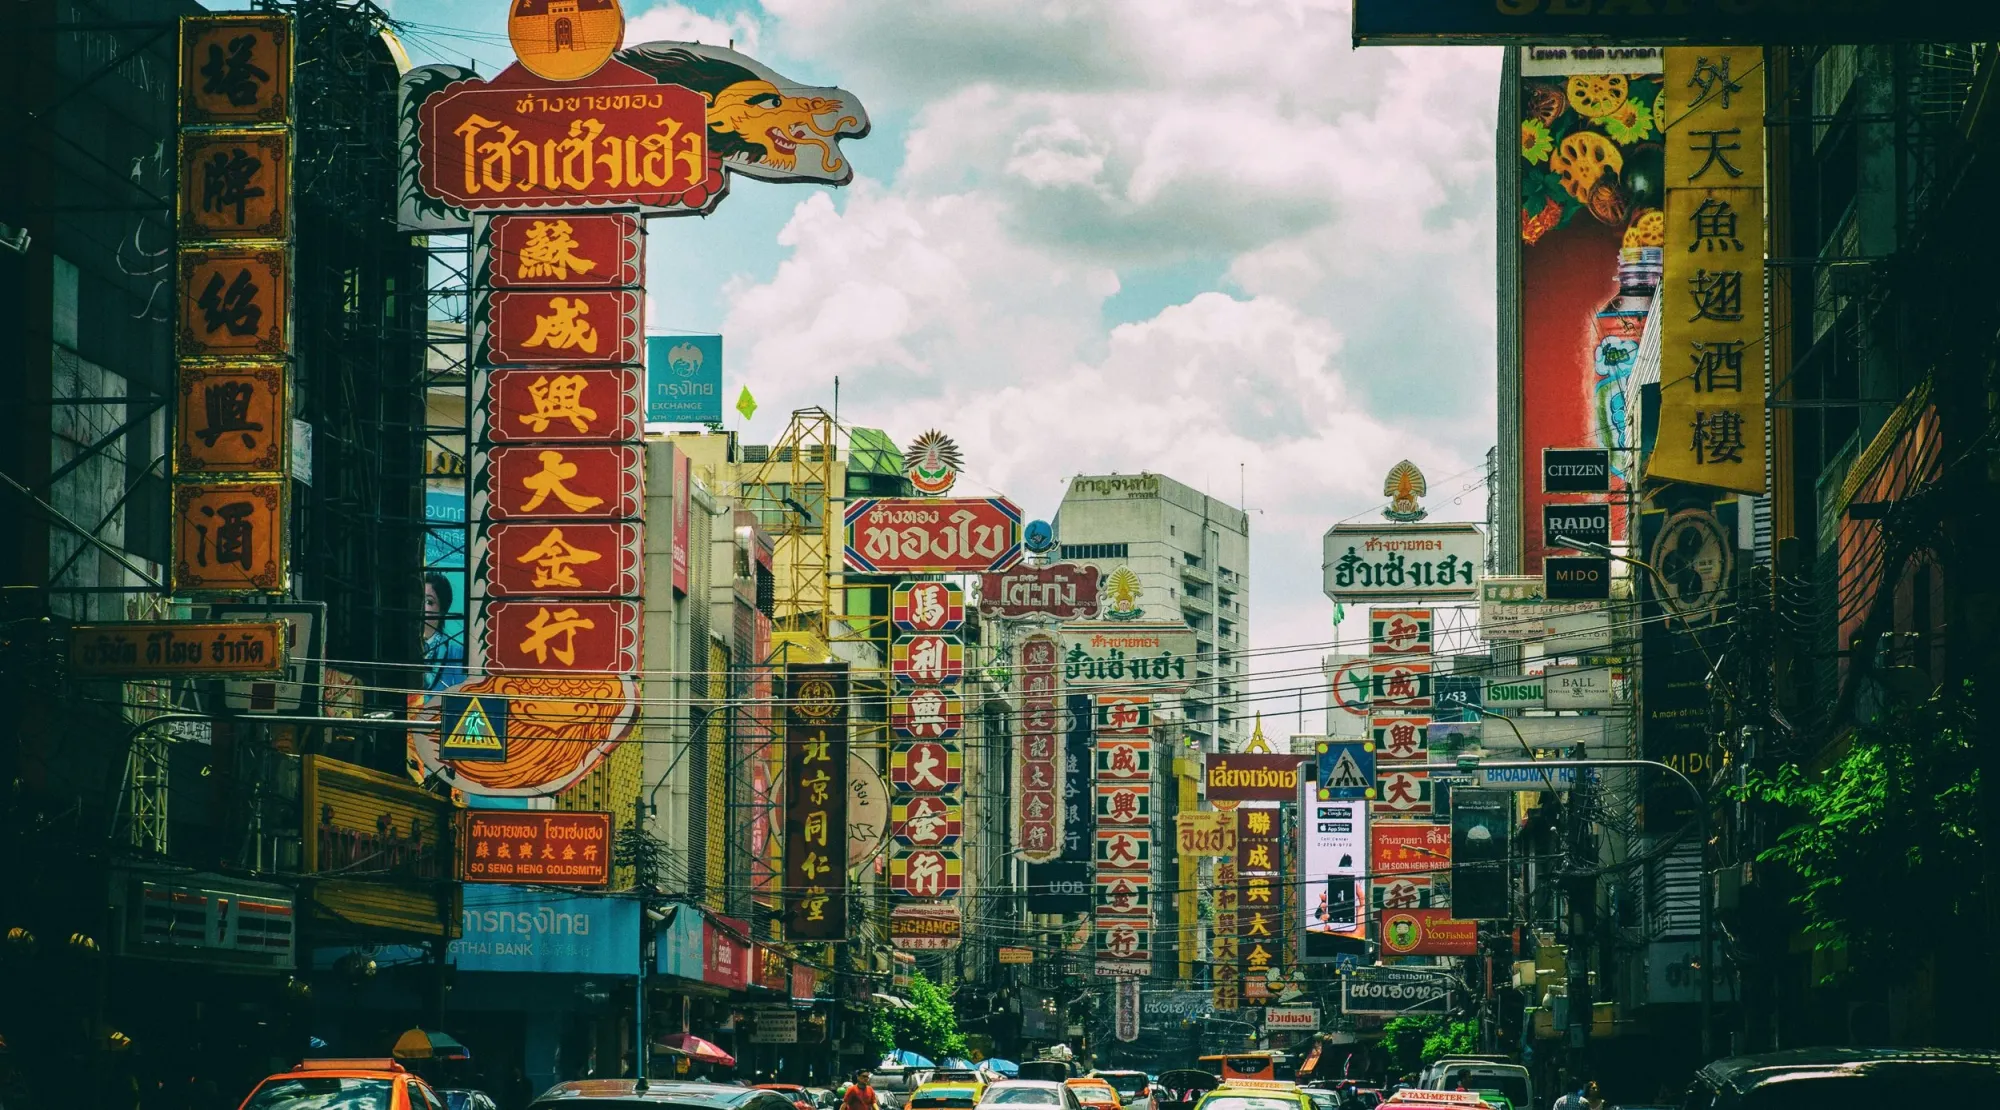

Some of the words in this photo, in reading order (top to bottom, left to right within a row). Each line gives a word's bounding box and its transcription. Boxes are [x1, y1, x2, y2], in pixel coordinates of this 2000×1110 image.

[516, 92, 664, 114] ห้างขายทอง
[1686, 55, 1746, 465] 外天魚翅酒樓
[195, 33, 271, 570] 塔牌紹興酒
[657, 380, 714, 399] กรุงไทย
[651, 402, 703, 410] EXCHANGE
[517, 220, 605, 667] 蘇成興大金行
[1547, 464, 1605, 477] CITIZEN
[869, 505, 940, 525] ห้างทอง
[1548, 516, 1606, 530] RADO
[864, 509, 1005, 560] ทองใบ
[1364, 537, 1443, 553] ห้างขายทอง
[1556, 570, 1599, 581] MIDO
[1562, 678, 1596, 687] BALL
[908, 585, 946, 895] 馬利興大金行
[1386, 619, 1419, 909] 和成興大行
[1208, 760, 1297, 788] เลี่ยงเซ่งเฮ
[1487, 767, 1552, 783] BROADWAY
[472, 819, 538, 839] ห้างขายทอง
[1109, 703, 1139, 955] 和成興大金行
[471, 863, 484, 873] SO
[488, 863, 513, 873] SENG
[517, 864, 543, 874] HENG
[546, 865, 602, 876] GOLDSMITH
[1378, 862, 1390, 870] LIM
[1050, 880, 1085, 894] UOB
[1246, 811, 1273, 1004] 聯成興大金
[891, 920, 960, 935] EXCHANGE
[1446, 931, 1474, 939] Fishball
[495, 943, 534, 956] BANK
